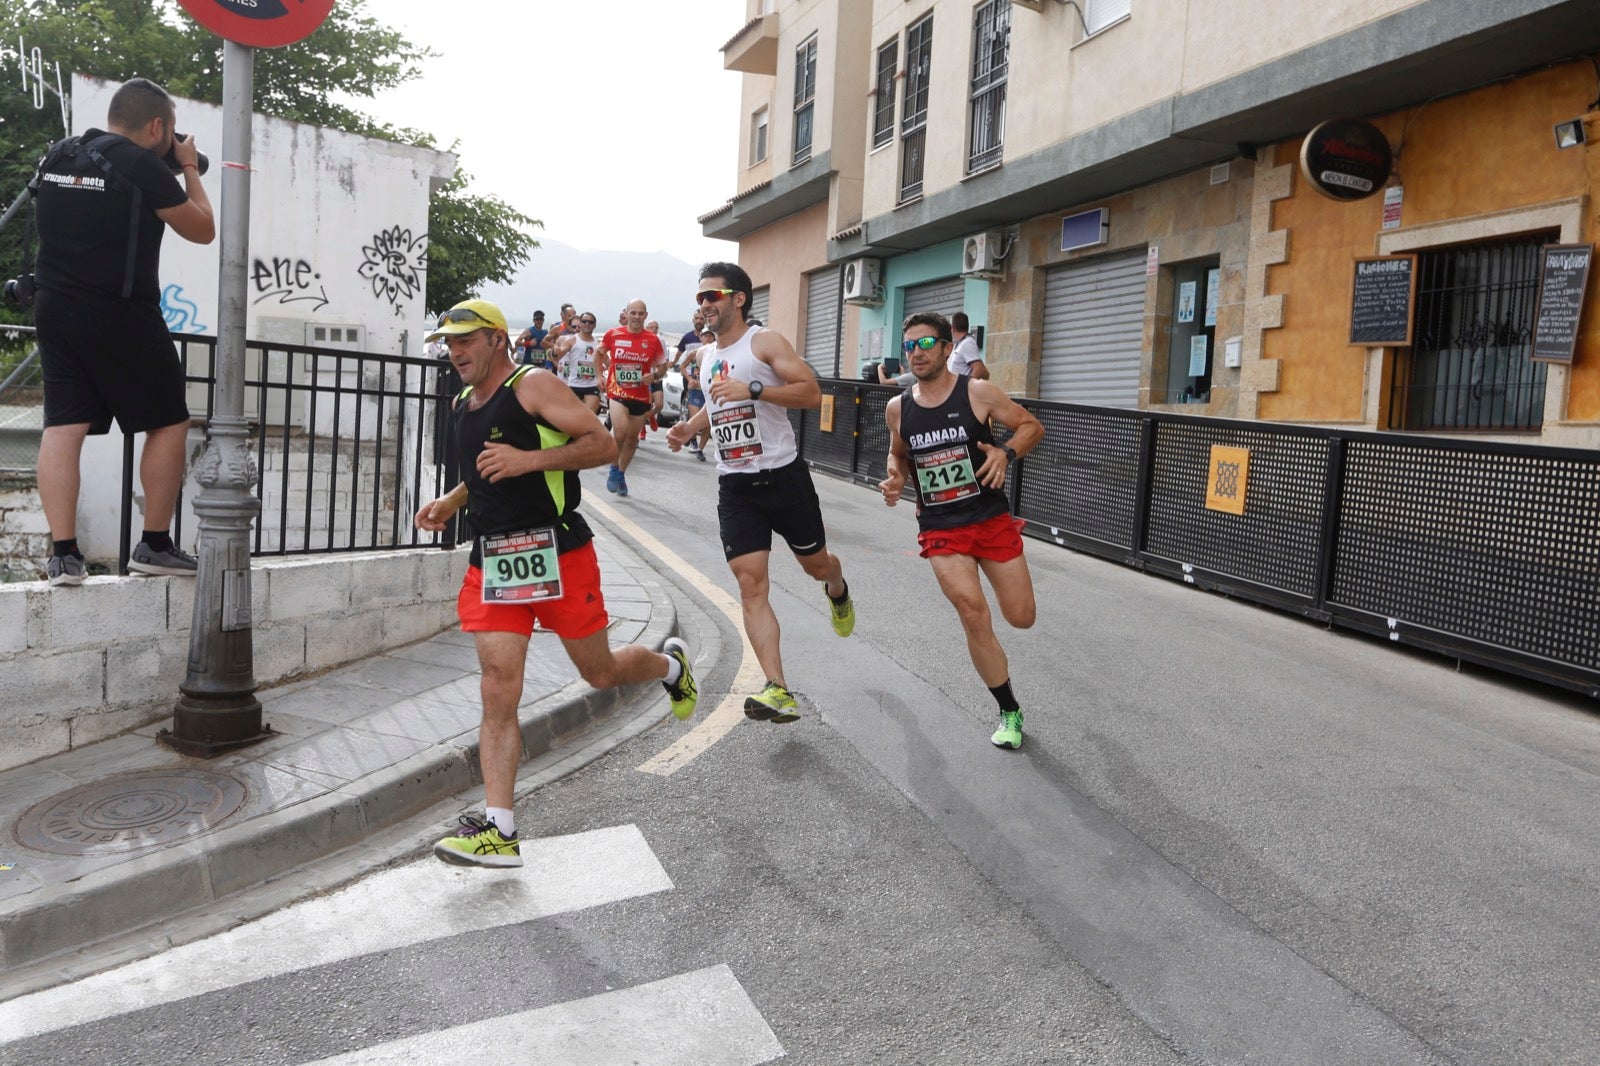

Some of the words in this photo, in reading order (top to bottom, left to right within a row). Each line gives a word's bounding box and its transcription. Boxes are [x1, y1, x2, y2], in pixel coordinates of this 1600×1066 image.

[620, 371, 638, 381] 603
[715, 422, 755, 444] 3070
[910, 425, 967, 447] GRANADA
[926, 464, 966, 488] 212
[497, 553, 547, 582] 908
